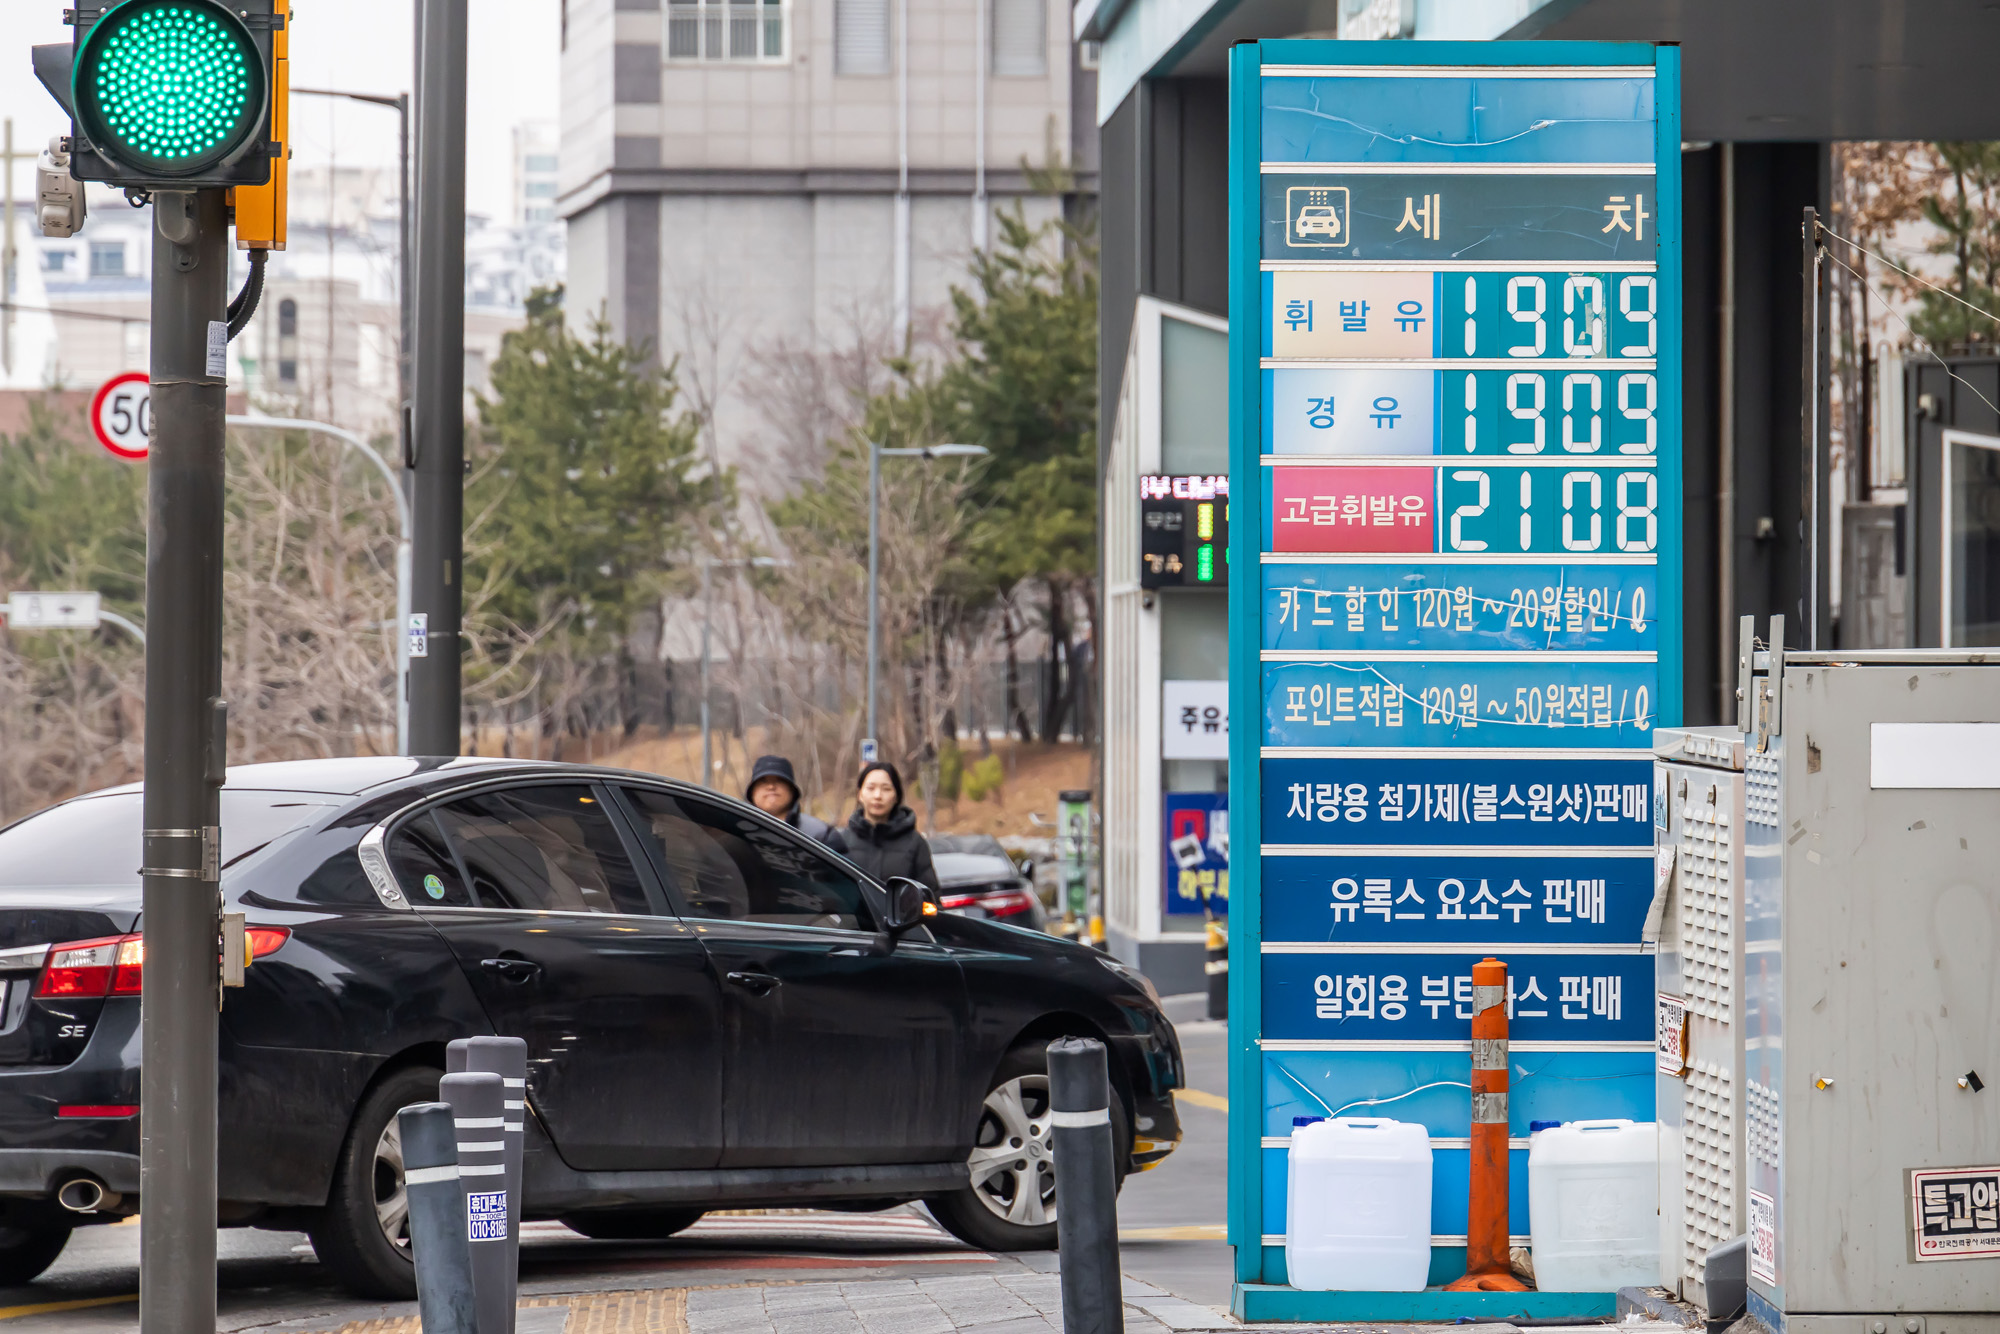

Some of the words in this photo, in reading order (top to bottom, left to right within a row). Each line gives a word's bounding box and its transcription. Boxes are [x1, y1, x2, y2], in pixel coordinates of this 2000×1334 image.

[1464, 275, 1658, 357] 1909
[1464, 372, 1658, 454] 1909
[1280, 494, 1427, 527] 고급휘발유
[1450, 470, 1658, 552] 2108
[1284, 683, 1404, 727] 포인트적립
[1287, 783, 1369, 823] 차량용
[1377, 783, 1648, 824] 첨가제(불스원샷)판매
[1328, 877, 1426, 923] 유록스
[1436, 877, 1533, 923] 요소수
[1542, 879, 1606, 924] 판매
[1313, 974, 1409, 1021] 일회용
[1419, 974, 1548, 1020] 부탄스
[1558, 975, 1622, 1021] 판매
[57, 1024, 87, 1037] SE
[1924, 1181, 1998, 1231] 특고압
